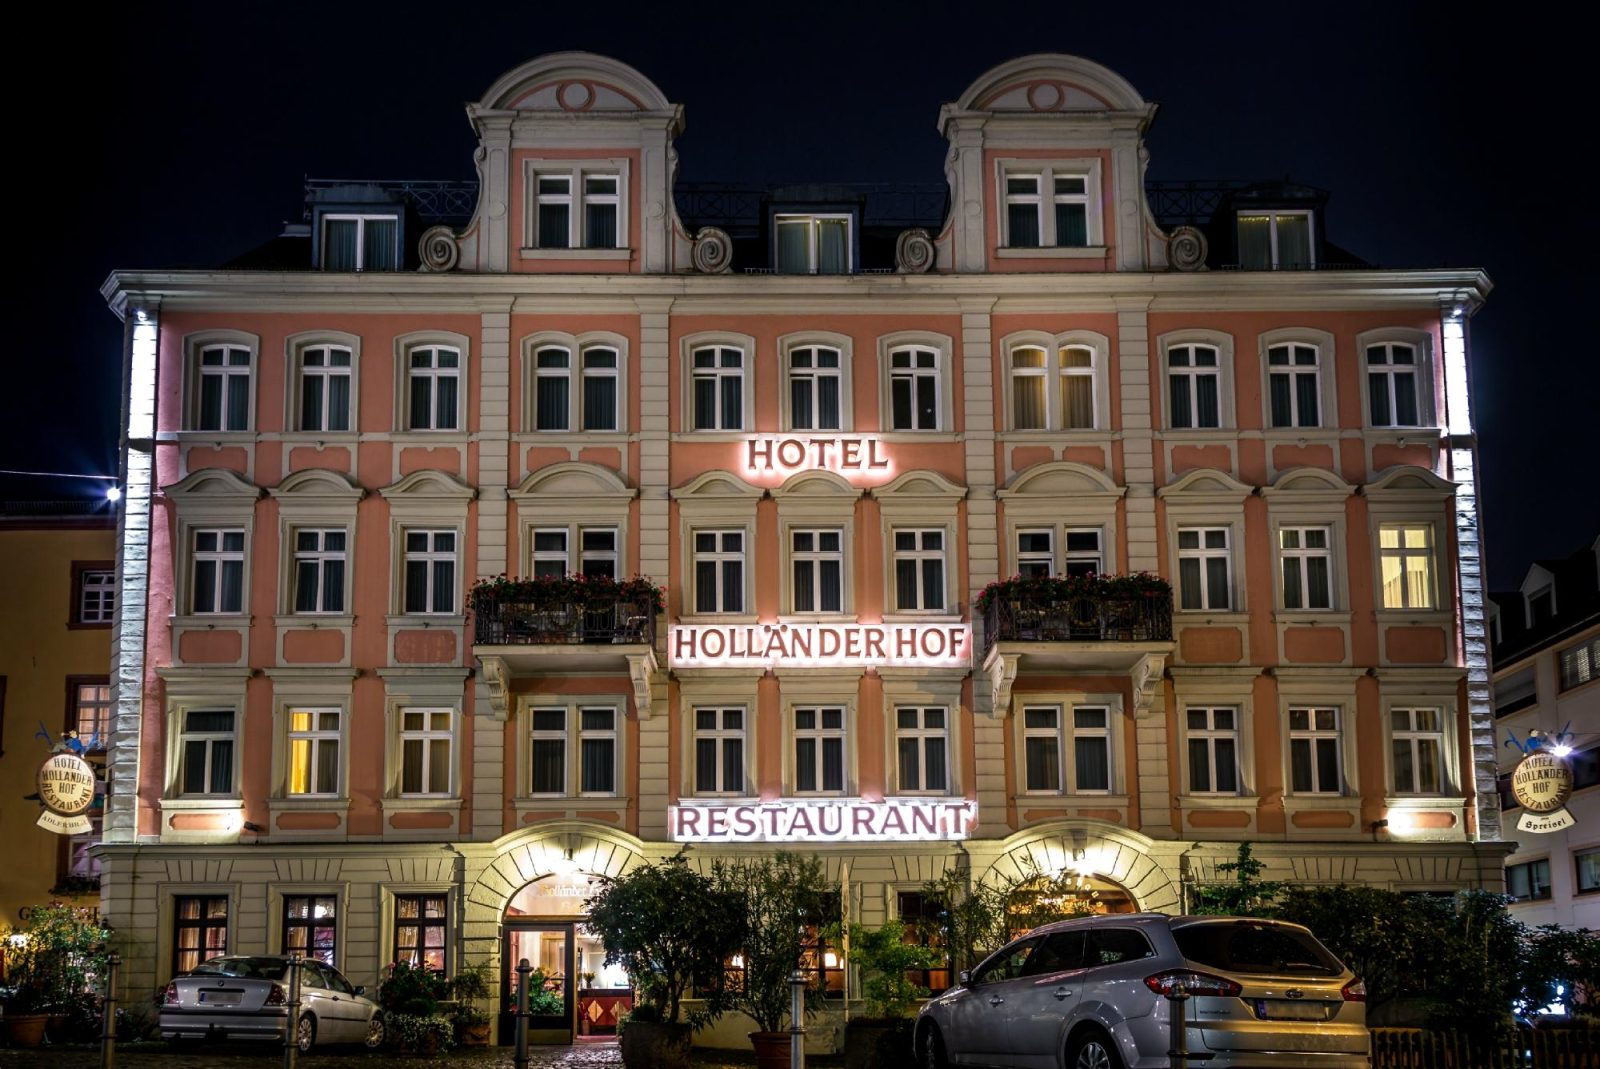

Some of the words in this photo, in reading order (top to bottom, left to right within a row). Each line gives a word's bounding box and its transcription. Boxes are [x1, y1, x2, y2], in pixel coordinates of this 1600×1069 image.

[748, 439, 888, 469] HOTEL
[675, 624, 885, 659] HOLLÄNDER
[896, 628, 965, 658] HOF
[54, 758, 81, 770] HOTEL
[1525, 757, 1554, 769] HOTEL
[42, 783, 92, 810] RESTAURANT
[59, 782, 77, 794] HOF
[1516, 783, 1568, 810] RESTAURANT
[1532, 781, 1551, 793] HOF
[677, 803, 971, 836] RESTAURANT
